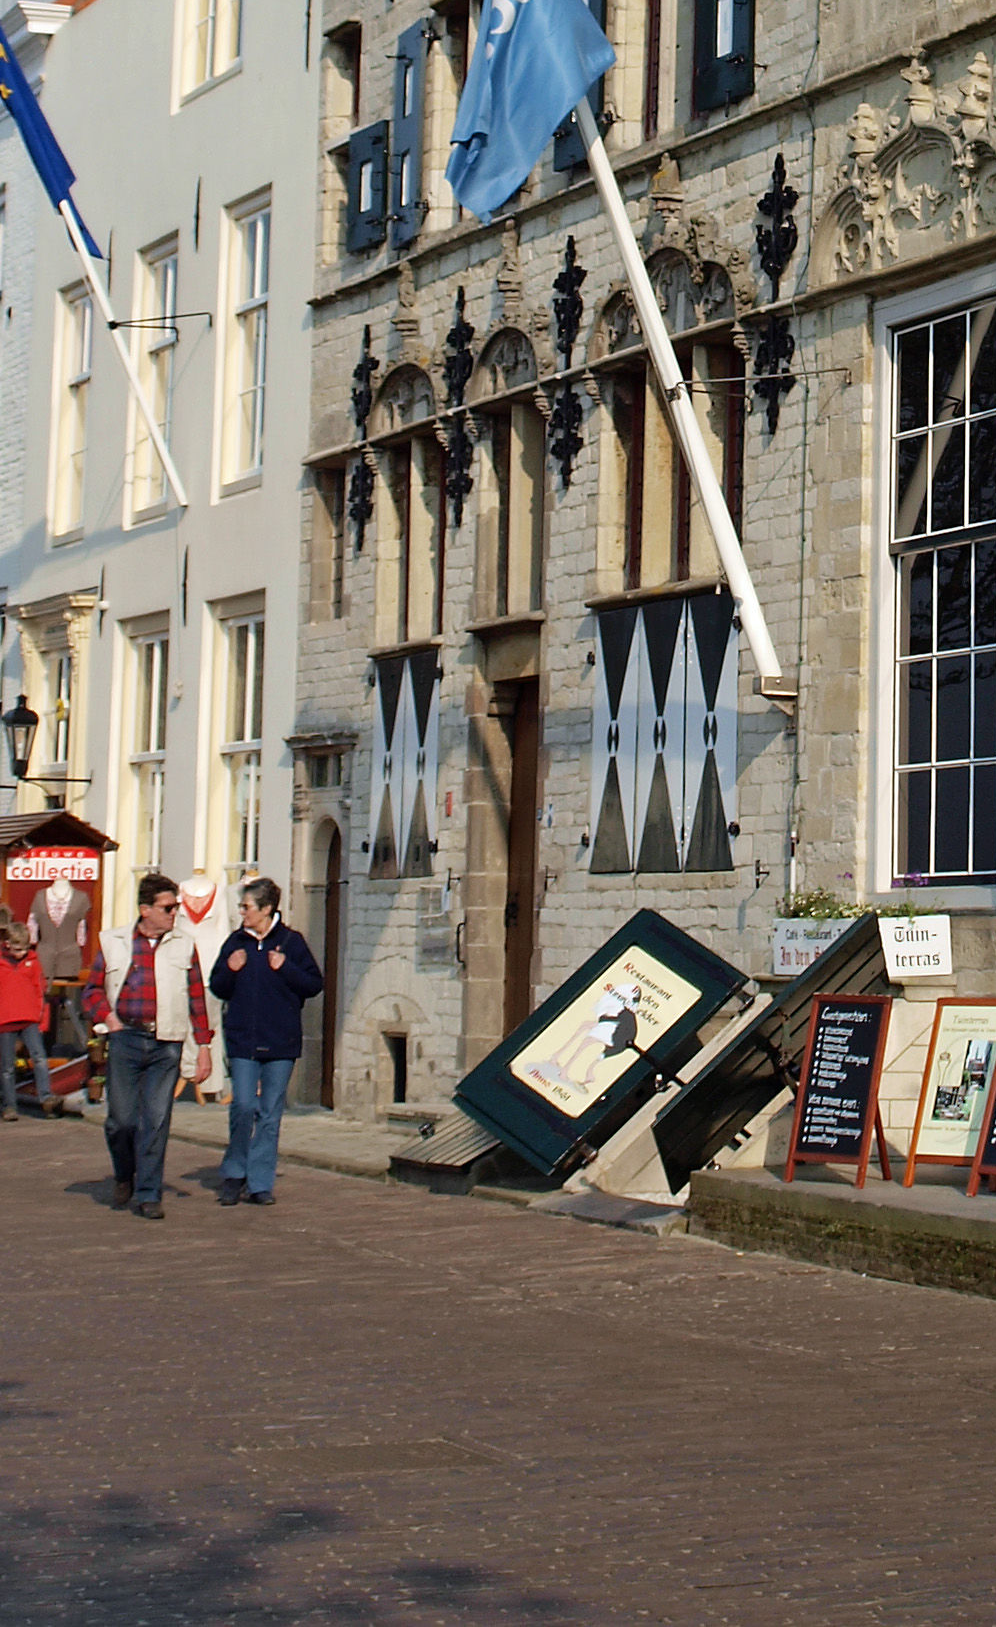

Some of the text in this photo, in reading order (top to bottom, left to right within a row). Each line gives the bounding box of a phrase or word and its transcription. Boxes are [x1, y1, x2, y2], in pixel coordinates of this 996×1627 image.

[12, 861, 94, 879] collectie
[894, 926, 938, 943] Tuin-
[896, 953, 941, 968] terras
[624, 962, 673, 1001] Restaurant
